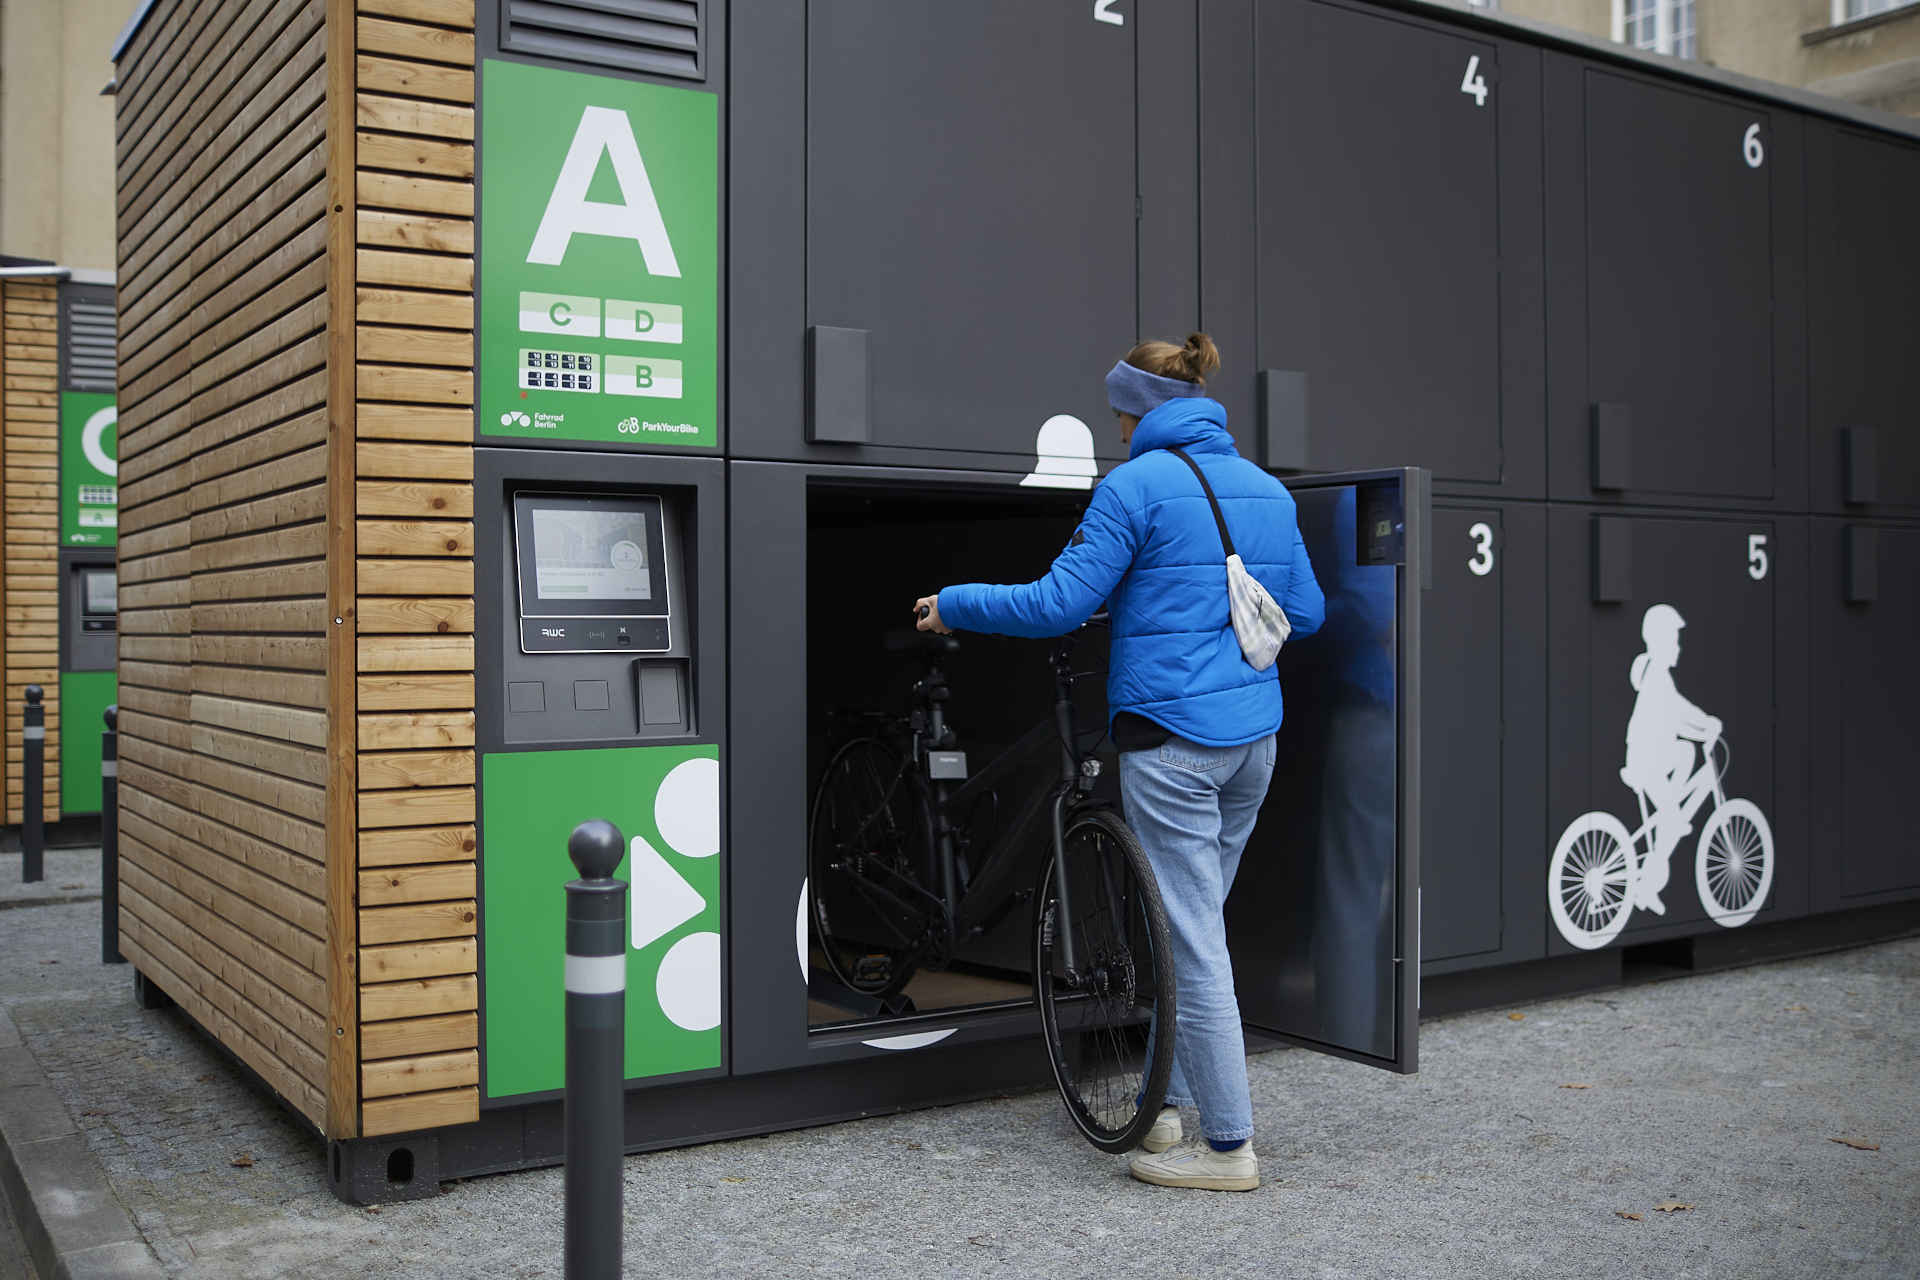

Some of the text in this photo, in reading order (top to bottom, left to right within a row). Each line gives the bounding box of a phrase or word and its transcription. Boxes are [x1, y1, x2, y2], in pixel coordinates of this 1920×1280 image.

[1461, 55, 1488, 107] 4
[1744, 123, 1763, 168] 6
[526, 104, 682, 279] A
[549, 302, 572, 326] C
[635, 309, 655, 333] D
[636, 365, 653, 388] B
[534, 413, 564, 422] Fahrrad
[534, 420, 557, 429] Berlin
[642, 421, 699, 434] ParkYourBike
[1467, 522, 1494, 576] 3
[1748, 534, 1769, 580] 5
